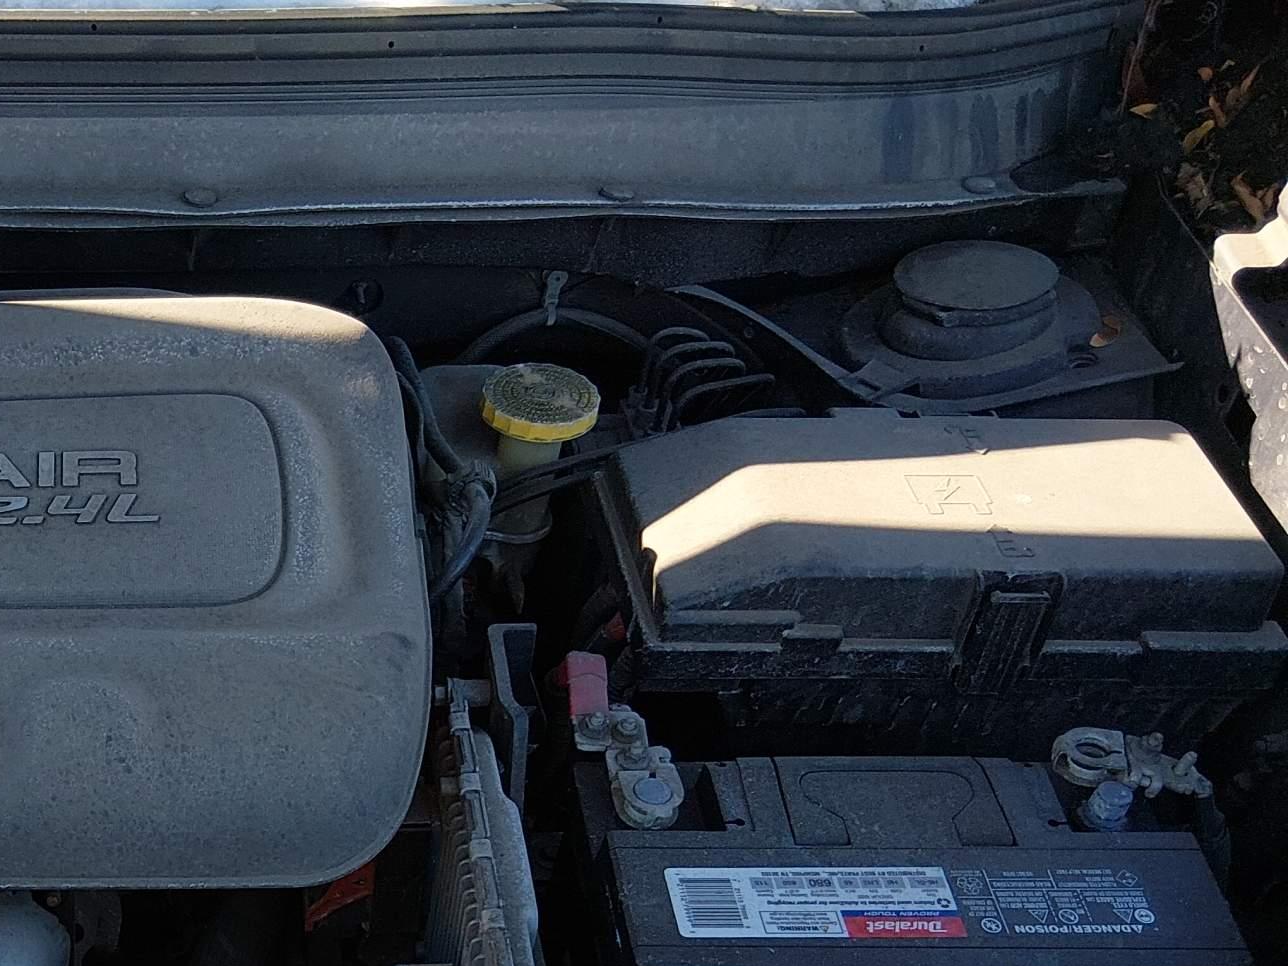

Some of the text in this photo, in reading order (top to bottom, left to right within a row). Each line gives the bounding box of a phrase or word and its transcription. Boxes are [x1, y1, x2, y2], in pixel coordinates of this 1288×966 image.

[808, 878, 832, 888] 680
[866, 920, 948, 933] Duralast
[1014, 924, 1132, 934] DANGER/POISON
